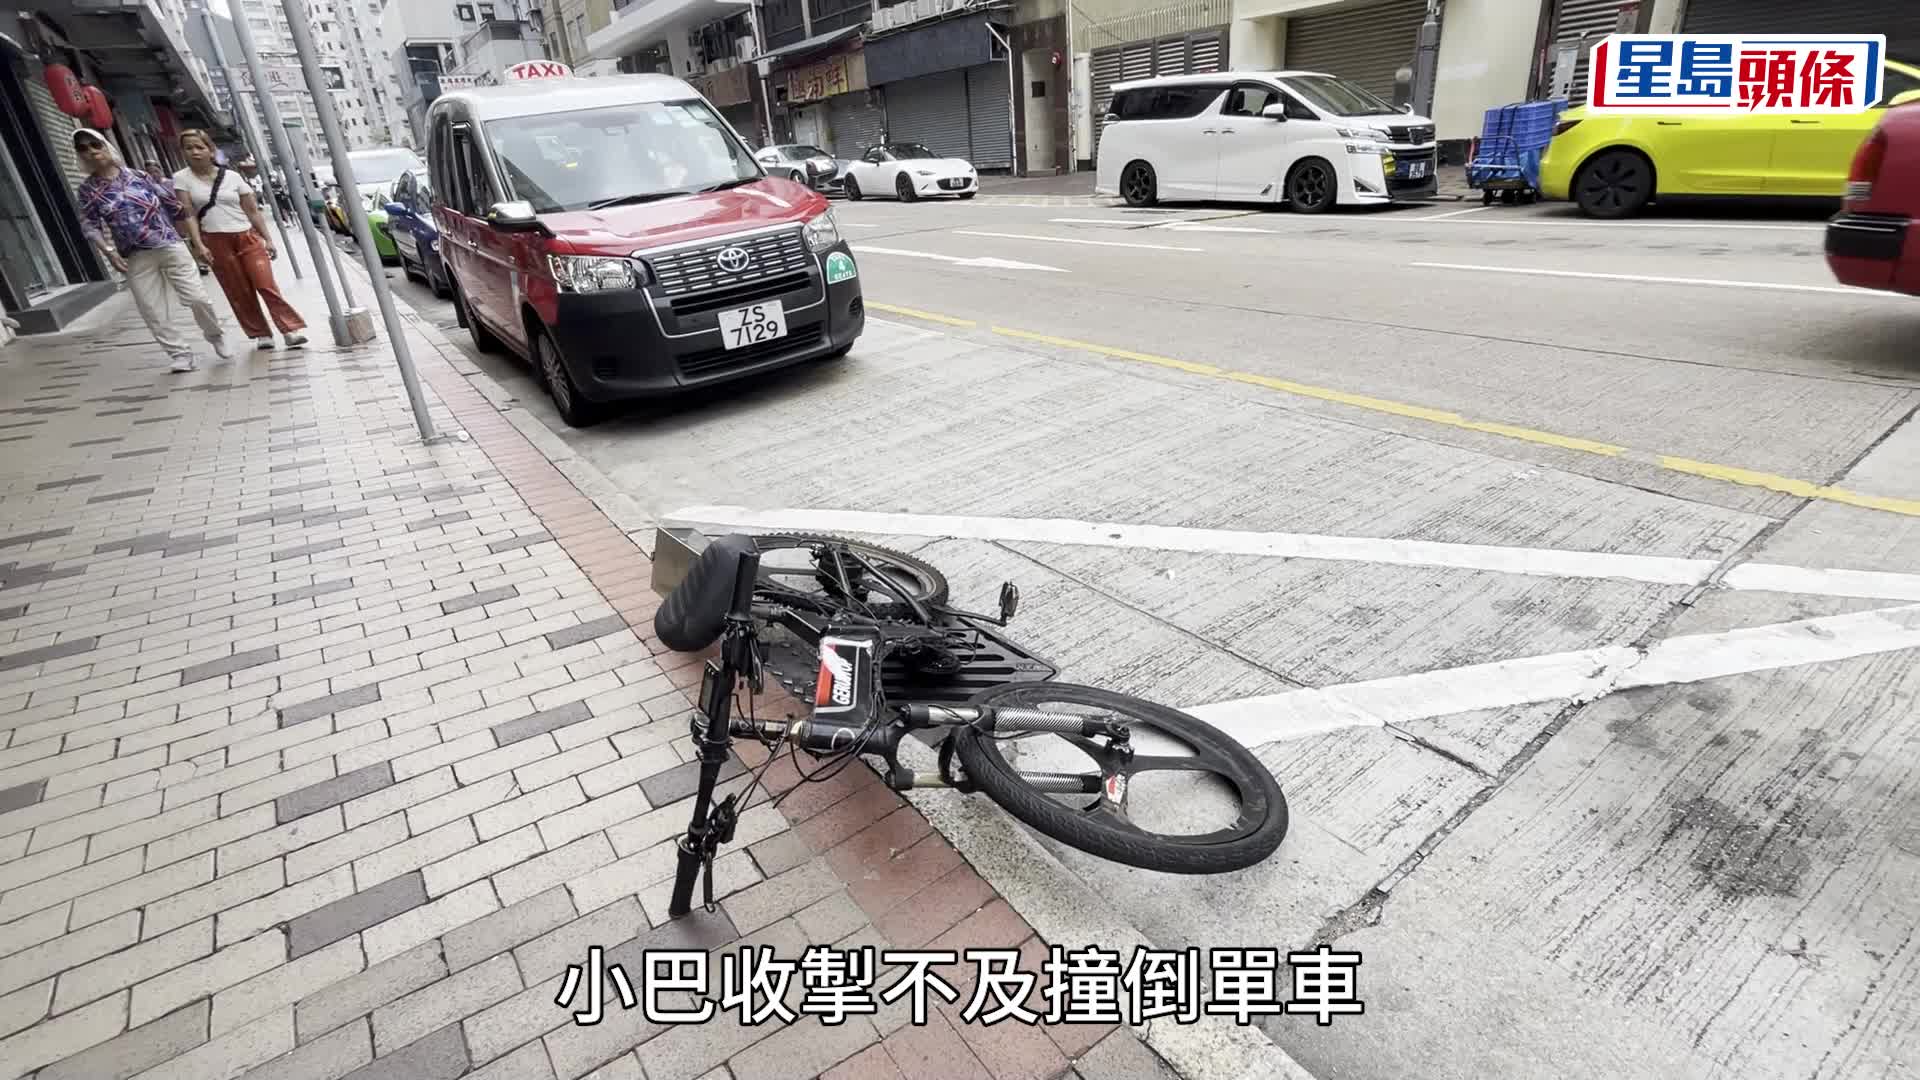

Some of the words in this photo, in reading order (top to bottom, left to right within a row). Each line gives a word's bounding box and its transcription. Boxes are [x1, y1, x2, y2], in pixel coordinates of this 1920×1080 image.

[513, 64, 564, 79] TAXI
[838, 260, 846, 270] 4
[738, 305, 766, 326] ZS
[730, 320, 779, 346] 7129
